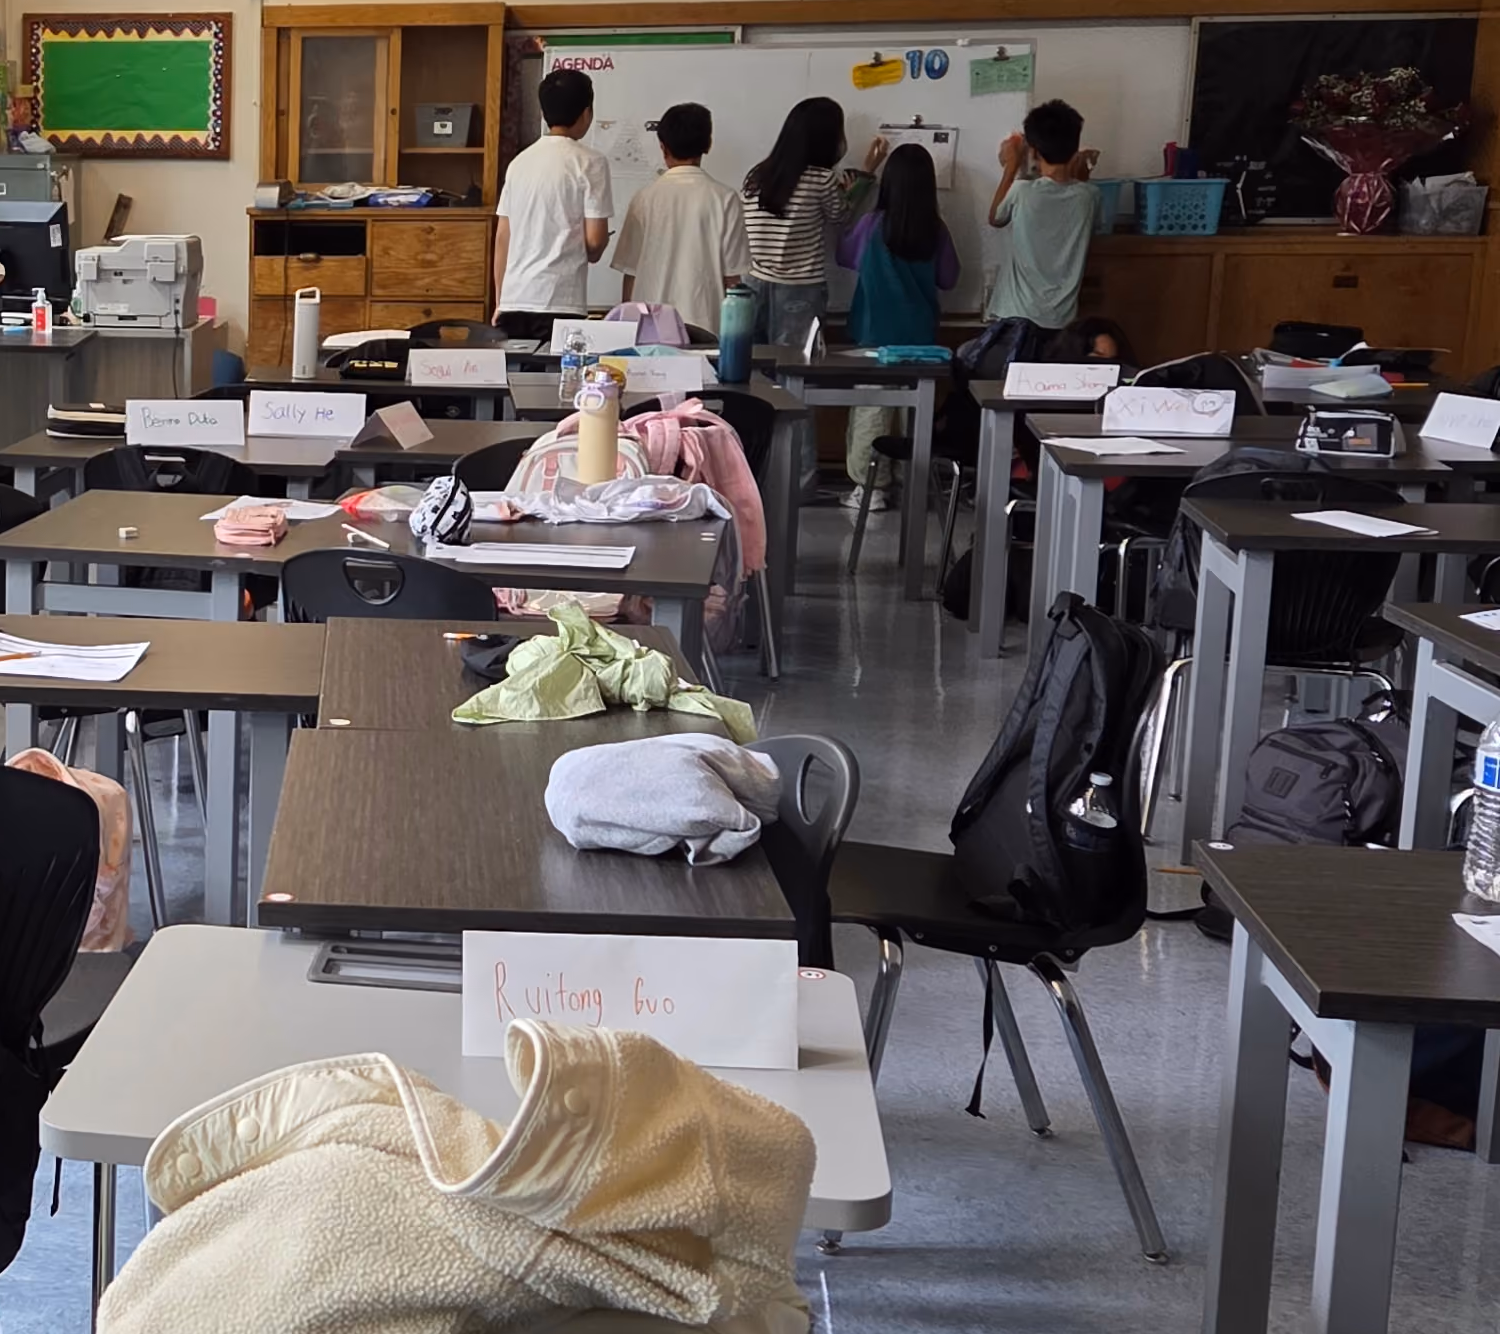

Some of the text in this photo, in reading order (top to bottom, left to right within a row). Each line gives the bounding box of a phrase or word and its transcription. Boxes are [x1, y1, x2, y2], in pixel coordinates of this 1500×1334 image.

[552, 56, 615, 72] AGENDA
[906, 49, 950, 80] 10
[260, 401, 335, 425] Sally He
[494, 960, 604, 1028] Ruitong
